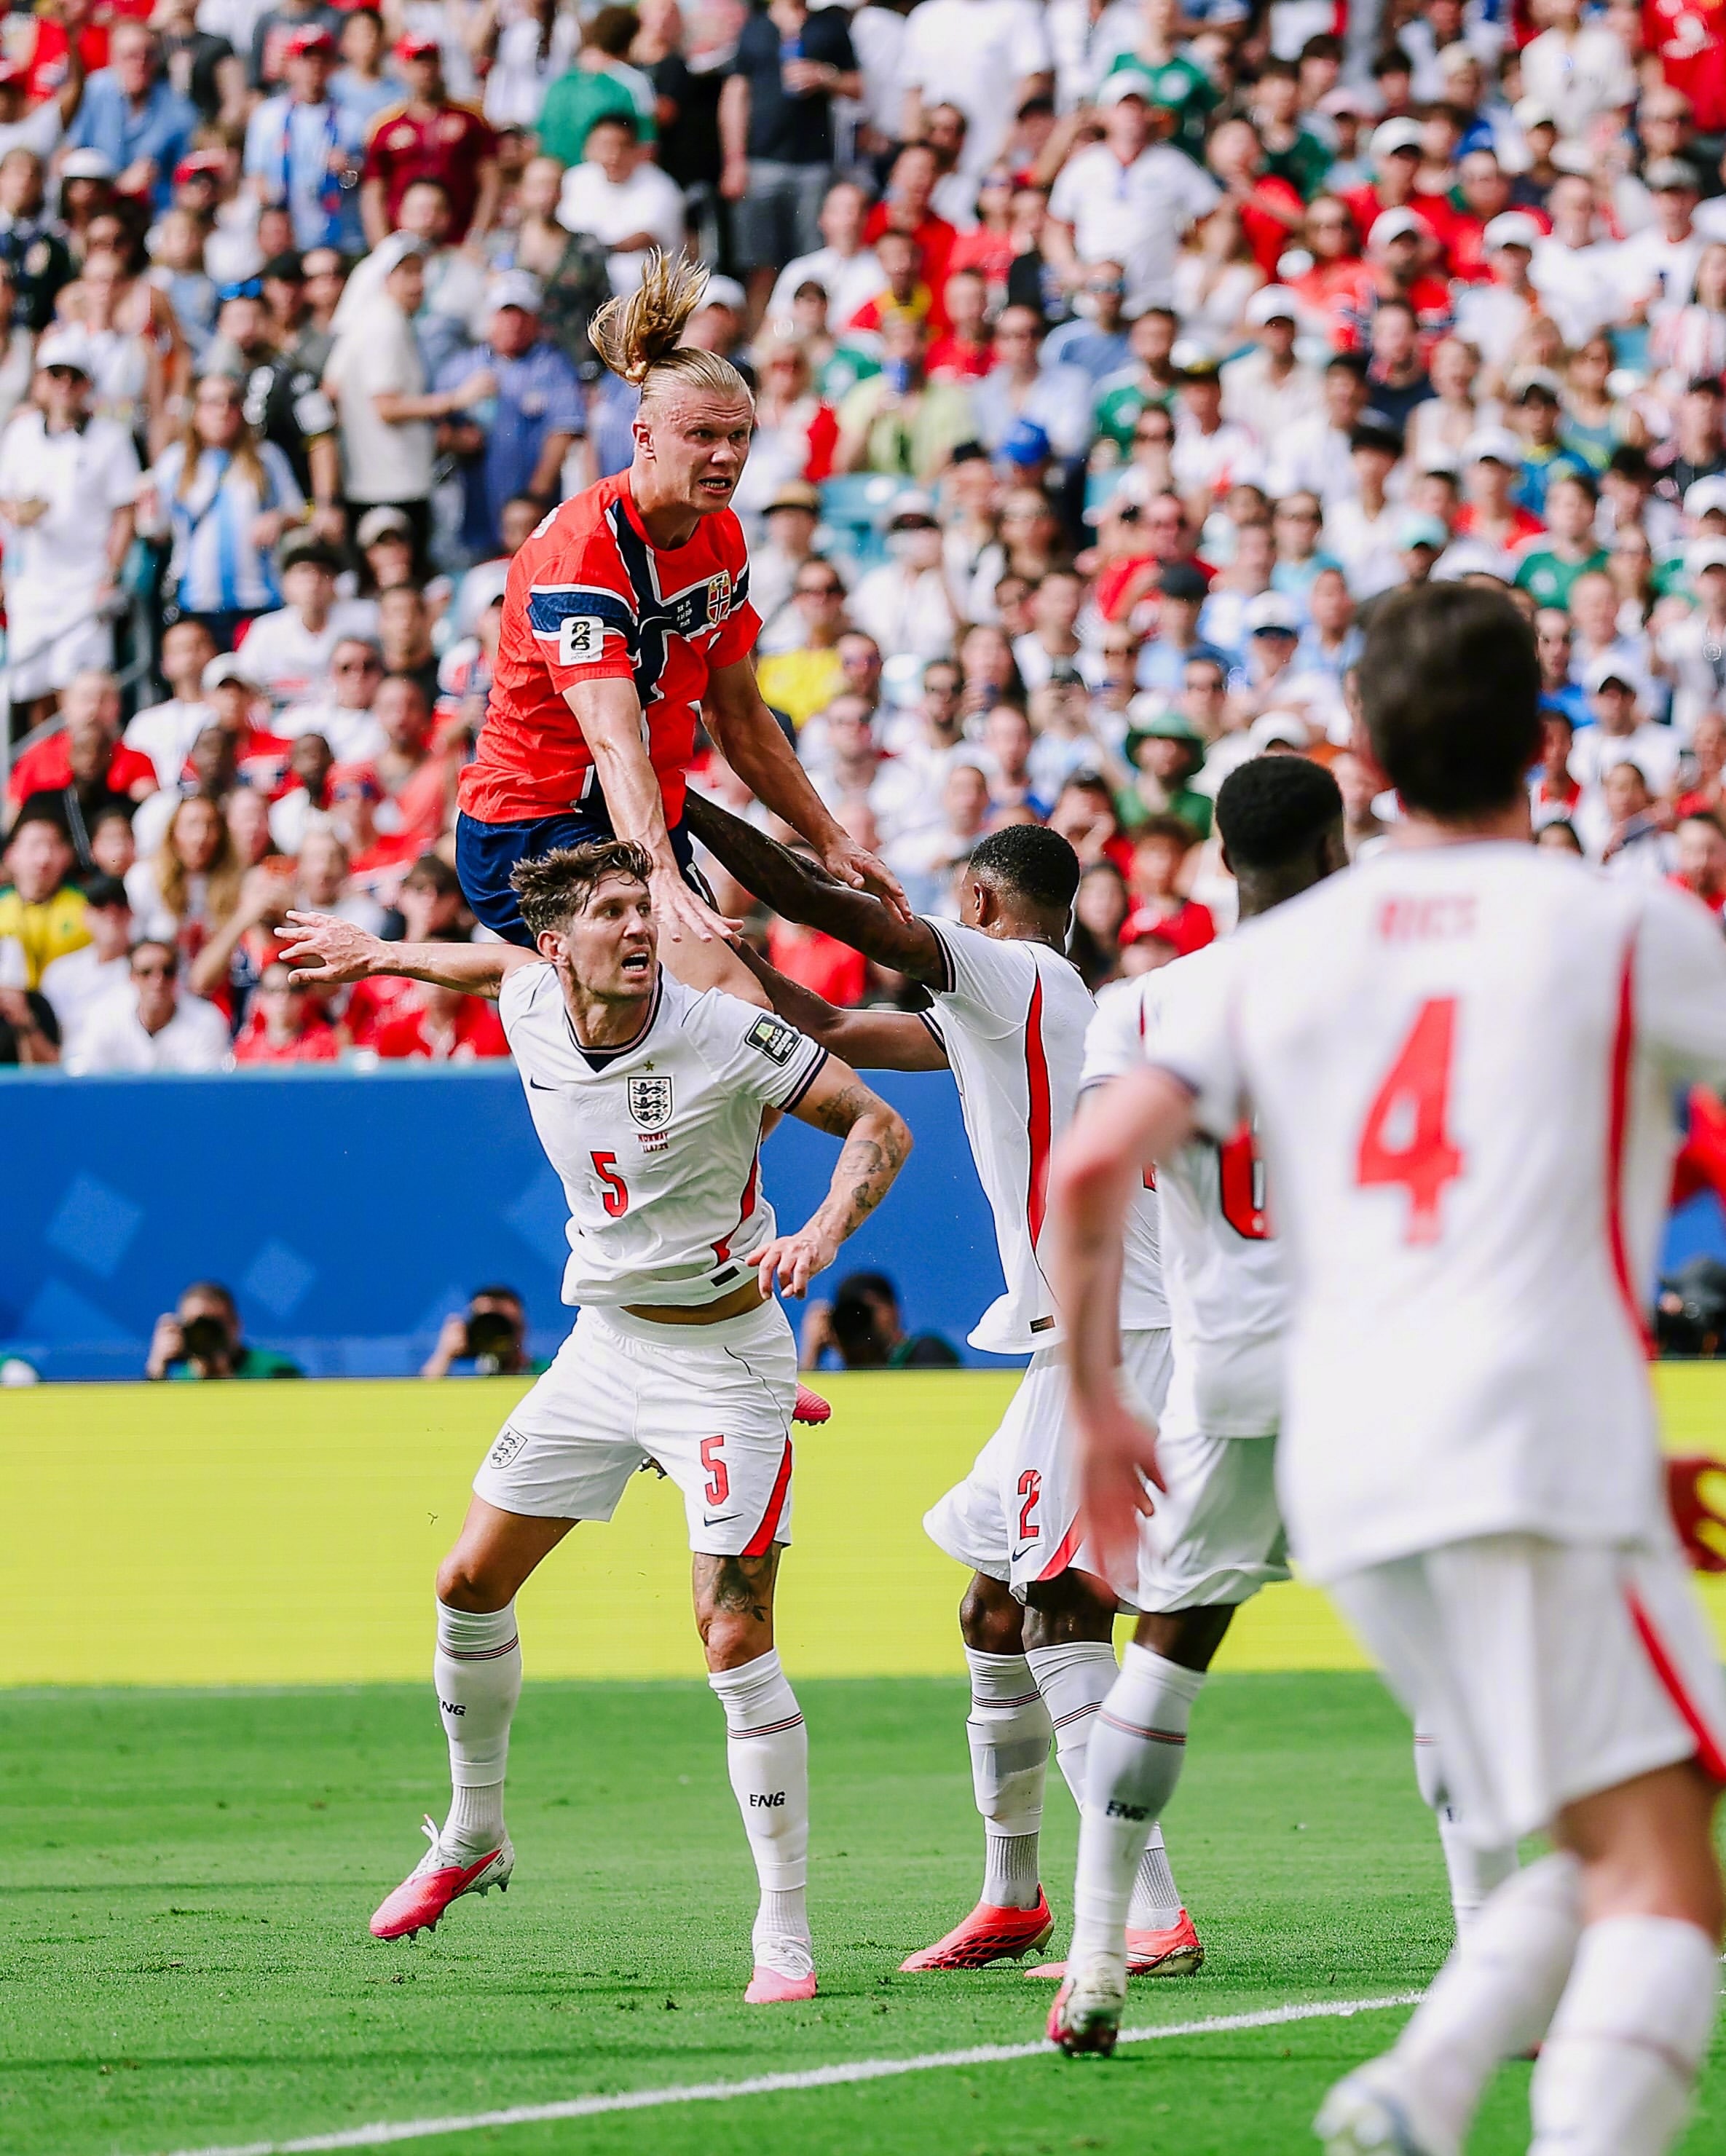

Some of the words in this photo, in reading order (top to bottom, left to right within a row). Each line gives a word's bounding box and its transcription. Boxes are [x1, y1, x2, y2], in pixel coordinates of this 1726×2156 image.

[638, 1132, 669, 1142] NORWAY
[1356, 996, 1465, 1244] 4
[590, 1150, 629, 1217] 5
[701, 1434, 729, 1507] 5
[1017, 1469, 1041, 1540] 2
[749, 1791, 786, 1807] ENG
